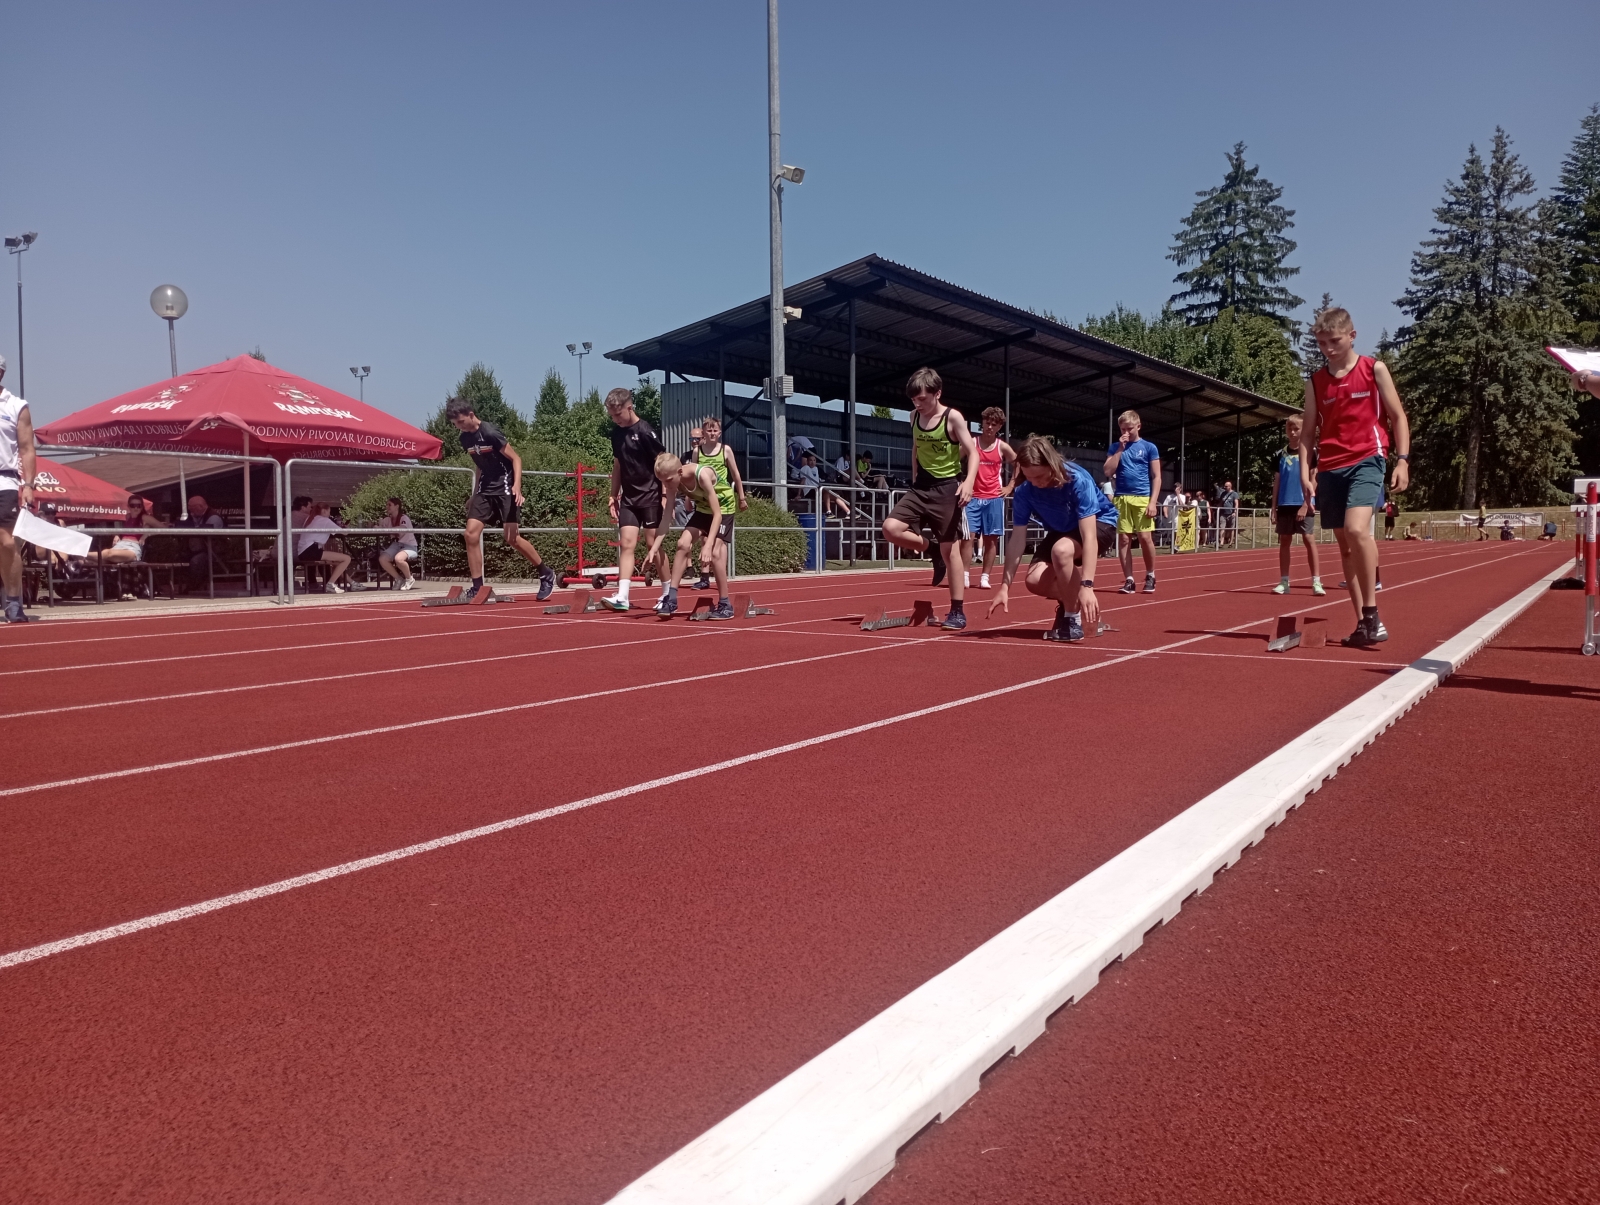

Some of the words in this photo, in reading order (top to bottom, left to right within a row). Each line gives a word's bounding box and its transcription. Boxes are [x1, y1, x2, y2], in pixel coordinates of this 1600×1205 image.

[57, 426, 96, 443] RODINNÝ
[98, 425, 137, 438] PIVOVAR
[136, 425, 143, 434] V
[144, 422, 189, 435] DOBRUŠC
[249, 425, 306, 440] RODINNÝ
[308, 430, 355, 443] PIVOVAR
[356, 434, 364, 443] V
[365, 435, 417, 451] DOBRUŠCE
[57, 505, 127, 515] pivovardobruska
